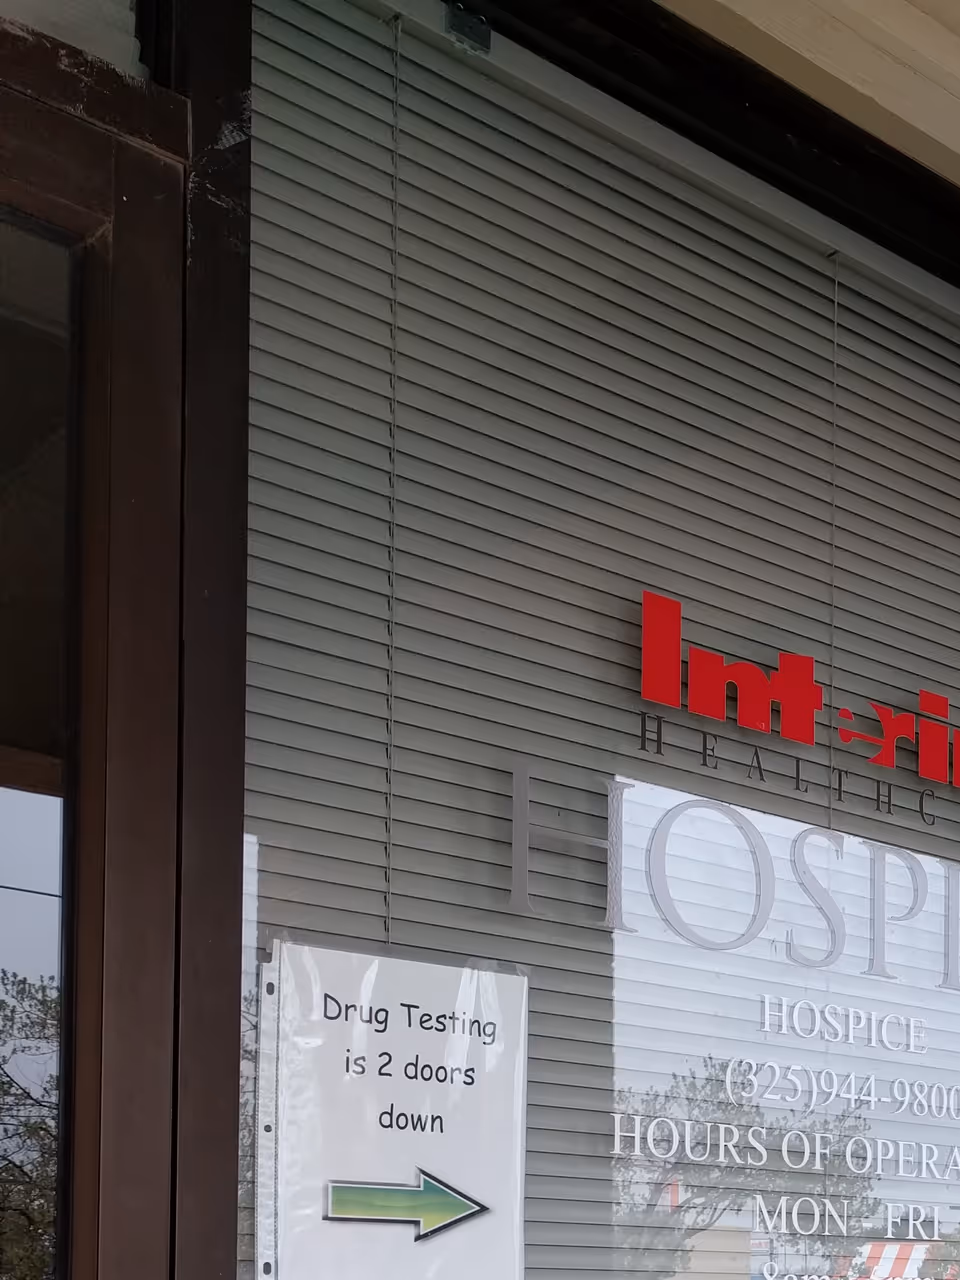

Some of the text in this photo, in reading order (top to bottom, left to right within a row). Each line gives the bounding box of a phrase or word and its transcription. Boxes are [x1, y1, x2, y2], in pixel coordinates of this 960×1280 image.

[323, 993, 497, 1046] Drug Testing
[760, 993, 930, 1055] HOSPICE
[345, 1049, 477, 1086] is 2 doors
[378, 1103, 445, 1134] down
[609, 1112, 768, 1168] HOURS
[781, 1130, 832, 1171] OF
[753, 1194, 849, 1237] MON
[885, 1202, 942, 1241] FRI
